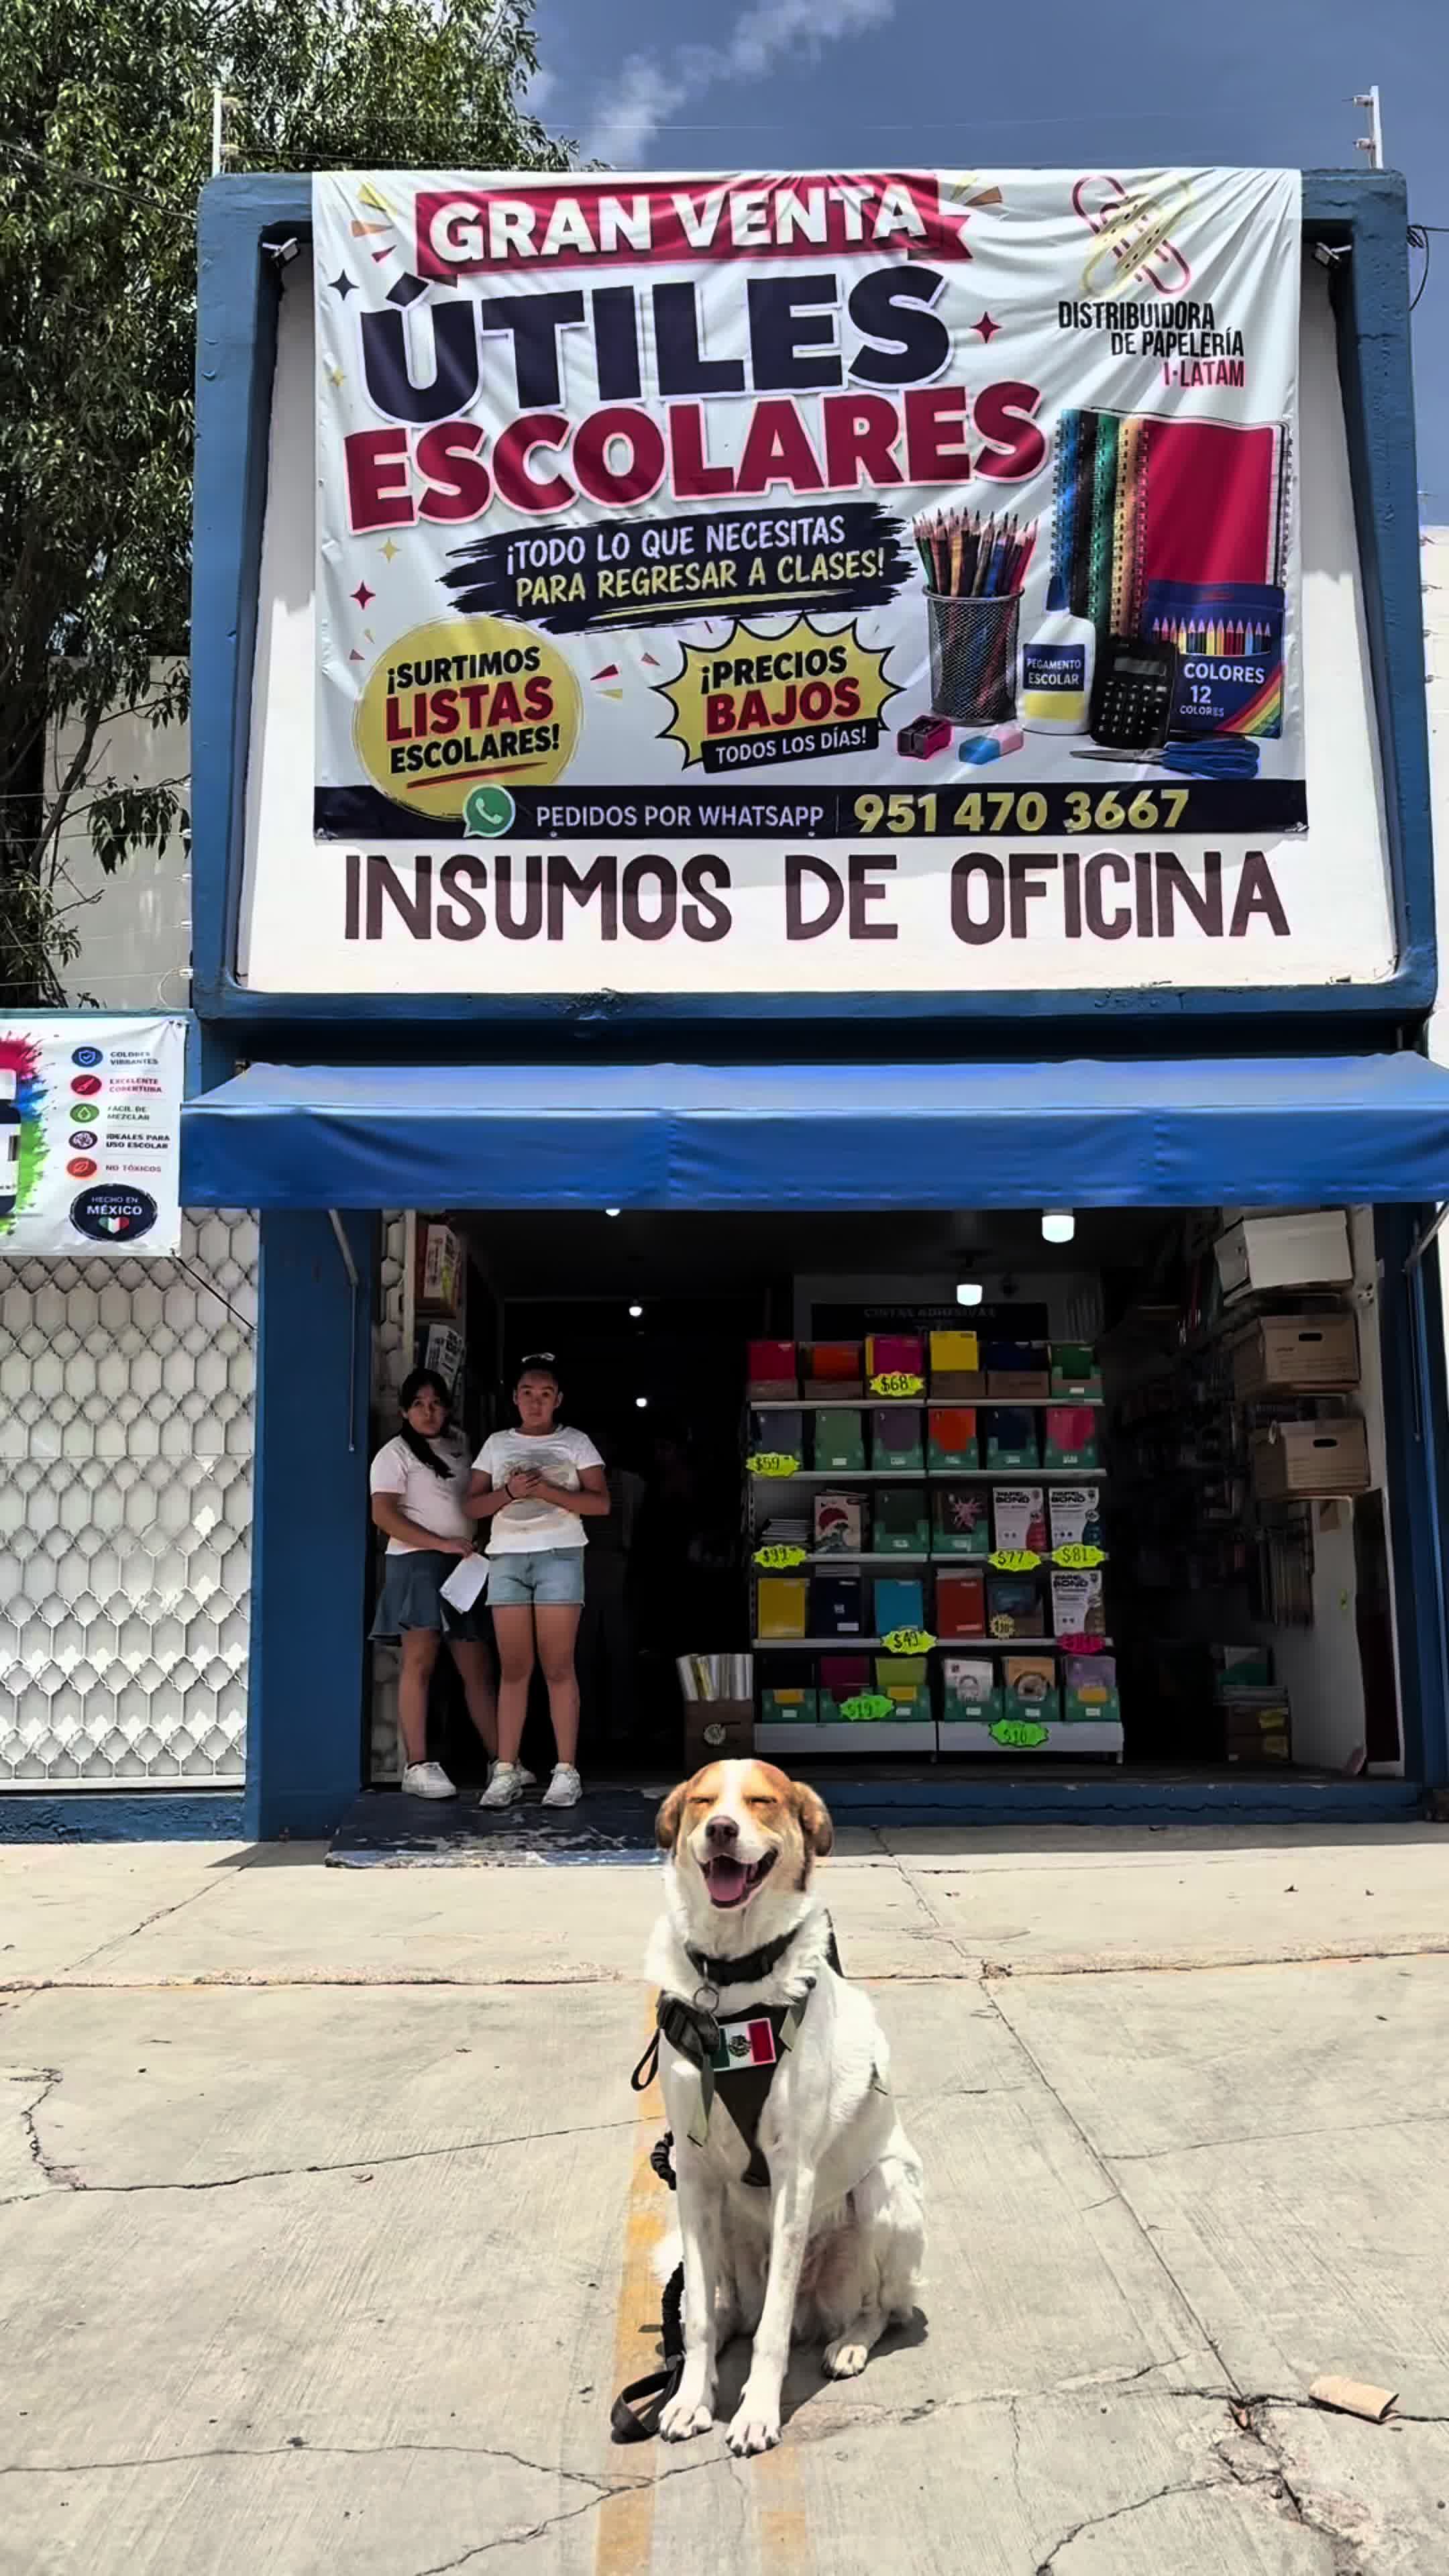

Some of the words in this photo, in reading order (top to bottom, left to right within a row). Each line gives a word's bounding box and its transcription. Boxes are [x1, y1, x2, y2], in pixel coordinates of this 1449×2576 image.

[429, 193, 652, 262] GRAN
[672, 183, 928, 248] VENTA
[1059, 301, 1214, 330] DISTRIBUIDORA
[360, 266, 950, 423] ÚTILES
[1112, 333, 1136, 356] DE
[1143, 327, 1244, 358] PAPELERÍA
[344, 381, 1046, 531] ESCOLARES
[506, 539, 586, 576] ¡TODO
[597, 533, 629, 561] LO
[642, 529, 695, 561] QUE
[706, 515, 845, 555] NECESITAS
[517, 572, 586, 607] PARA
[598, 558, 737, 600] REGRESAR
[749, 557, 766, 586] A
[777, 549, 884, 583] CLASES!
[387, 646, 541, 694] ¡SURTIMOS
[701, 643, 847, 694] ¡PRECIOS
[1026, 657, 1081, 672] PEGAMENTO
[1028, 672, 1079, 686] ESCOLAR
[1184, 662, 1265, 684] COLORES
[386, 676, 553, 741] LISTAS
[706, 677, 861, 735] BAJOS
[1180, 705, 1225, 718] COLORES
[1191, 686, 1212, 703] 12
[390, 724, 560, 774] ESCOLARES!
[716, 740, 776, 765] TODOS
[782, 736, 816, 754] LOS
[821, 724, 867, 749] DÍAS!
[537, 806, 637, 827] PEDIDOS
[645, 806, 690, 826] POR
[698, 805, 824, 827] WHATSAPP
[854, 794, 937, 834] 951
[955, 792, 1048, 832] 470
[1064, 789, 1189, 833] 3667
[344, 854, 733, 943] INSUMOS
[785, 854, 898, 941] DE
[951, 851, 1291, 945] OFICINA
[87, 1203, 143, 1215] MÉXICO
